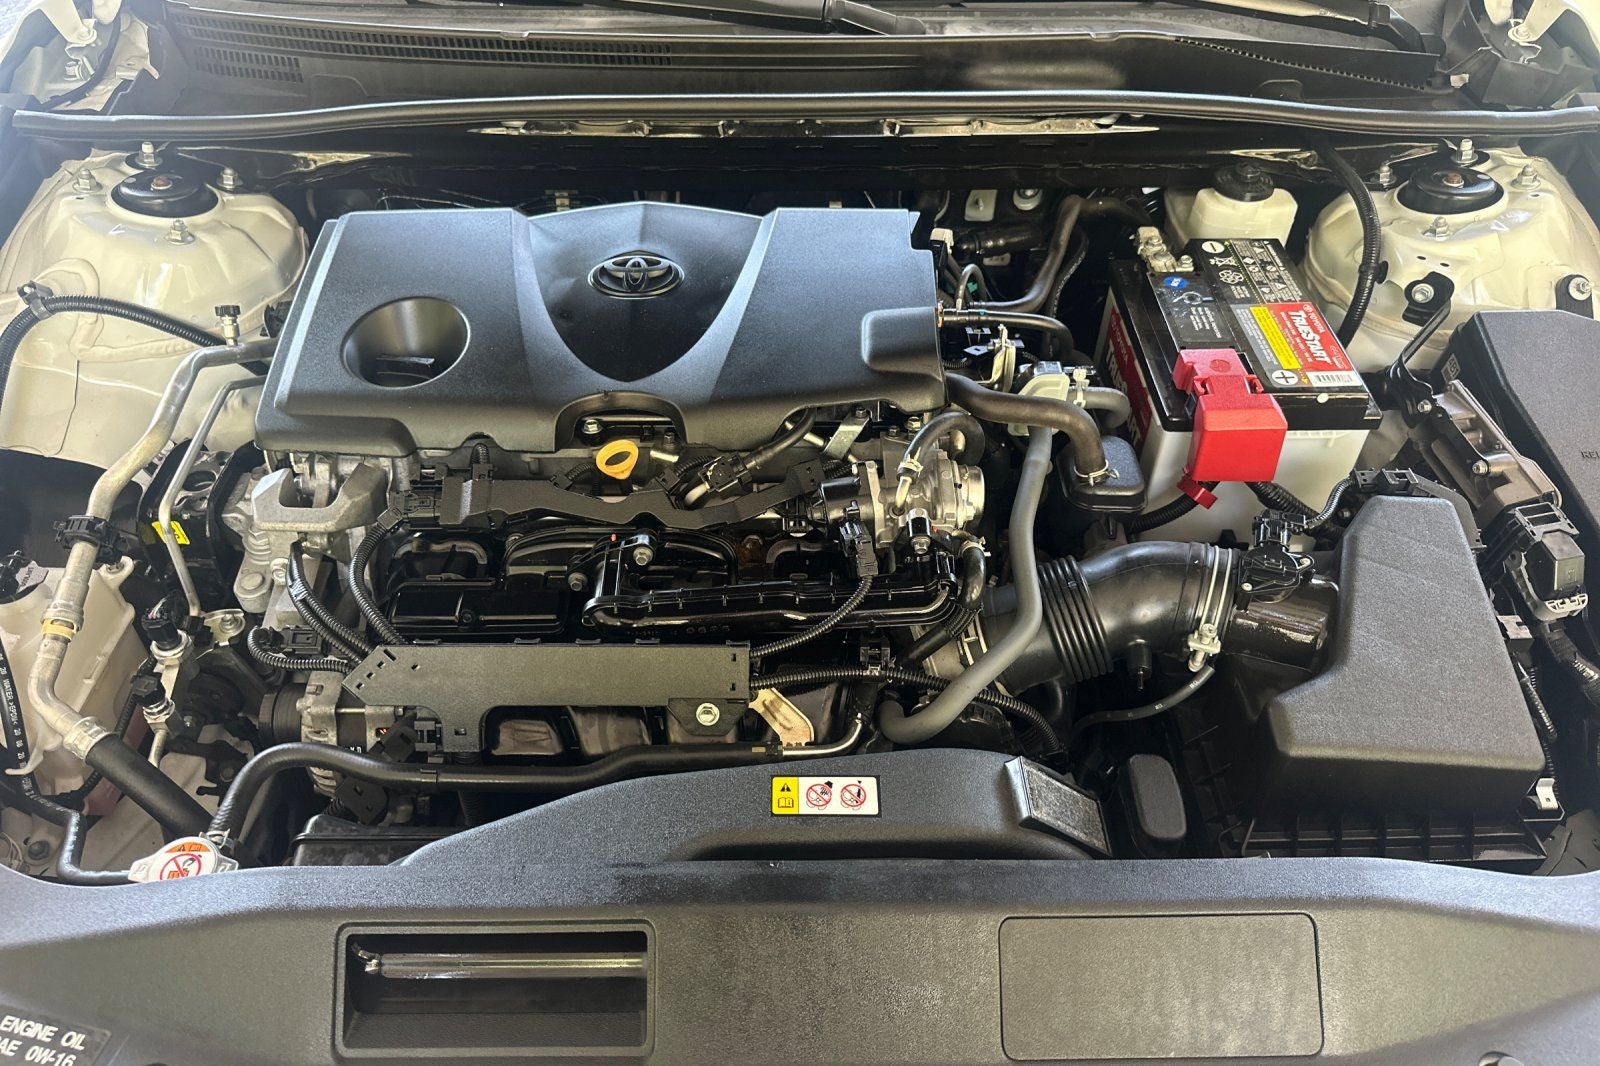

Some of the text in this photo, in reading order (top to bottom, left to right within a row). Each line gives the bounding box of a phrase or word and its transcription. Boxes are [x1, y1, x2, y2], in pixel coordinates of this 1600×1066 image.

[1308, 312, 1325, 333] TOYOTA
[3, 678, 13, 701] WATER
[0, 1015, 86, 1051] ENGINE OIL
[0, 1036, 76, 1066] AE 0W-16
